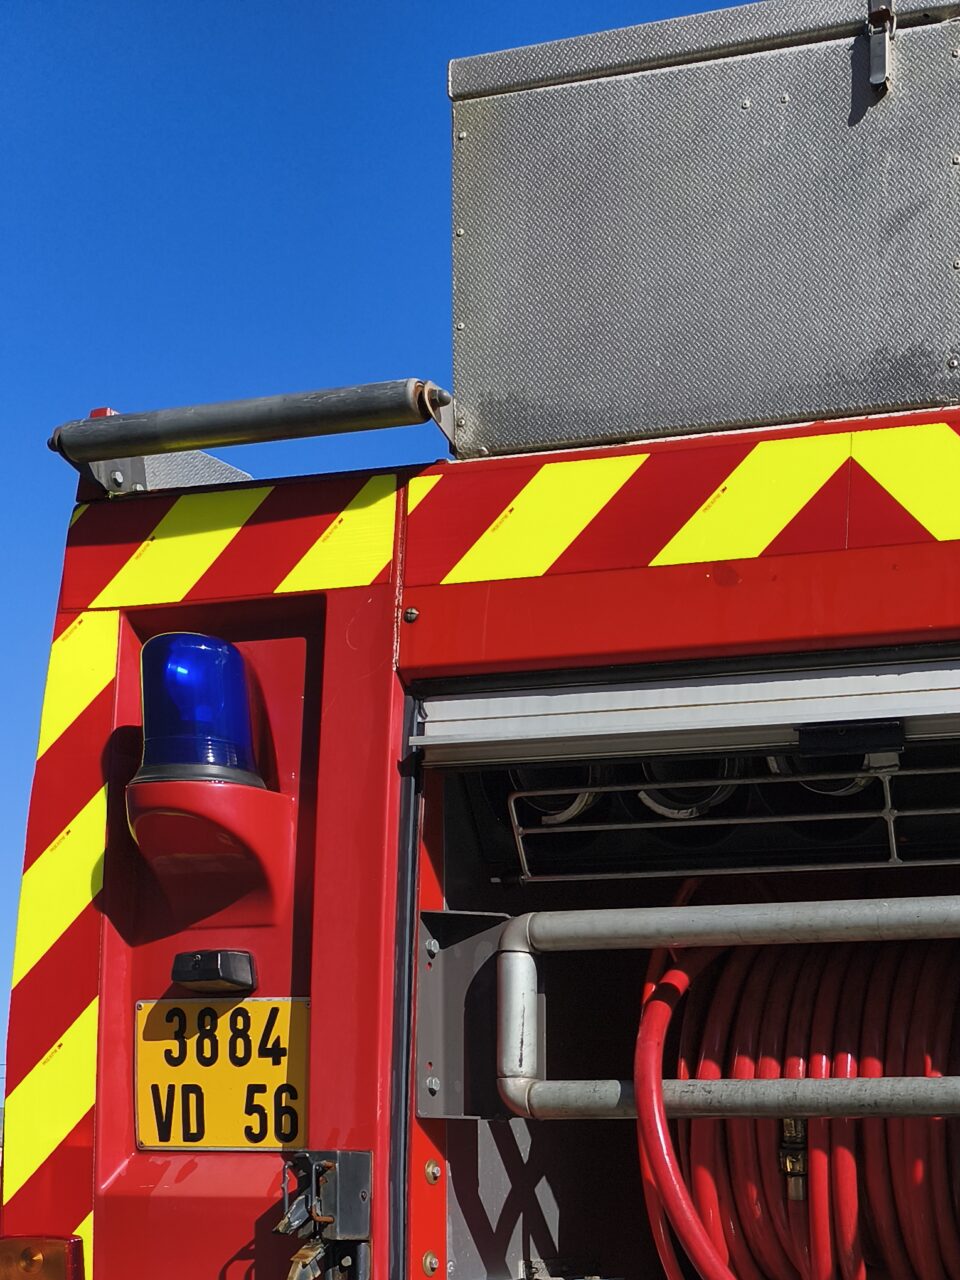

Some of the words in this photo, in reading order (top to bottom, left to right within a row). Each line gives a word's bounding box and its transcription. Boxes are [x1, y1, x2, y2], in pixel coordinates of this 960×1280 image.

[164, 1007, 287, 1067] 3884
[150, 1084, 205, 1142] VD
[244, 1084, 298, 1143] 56
